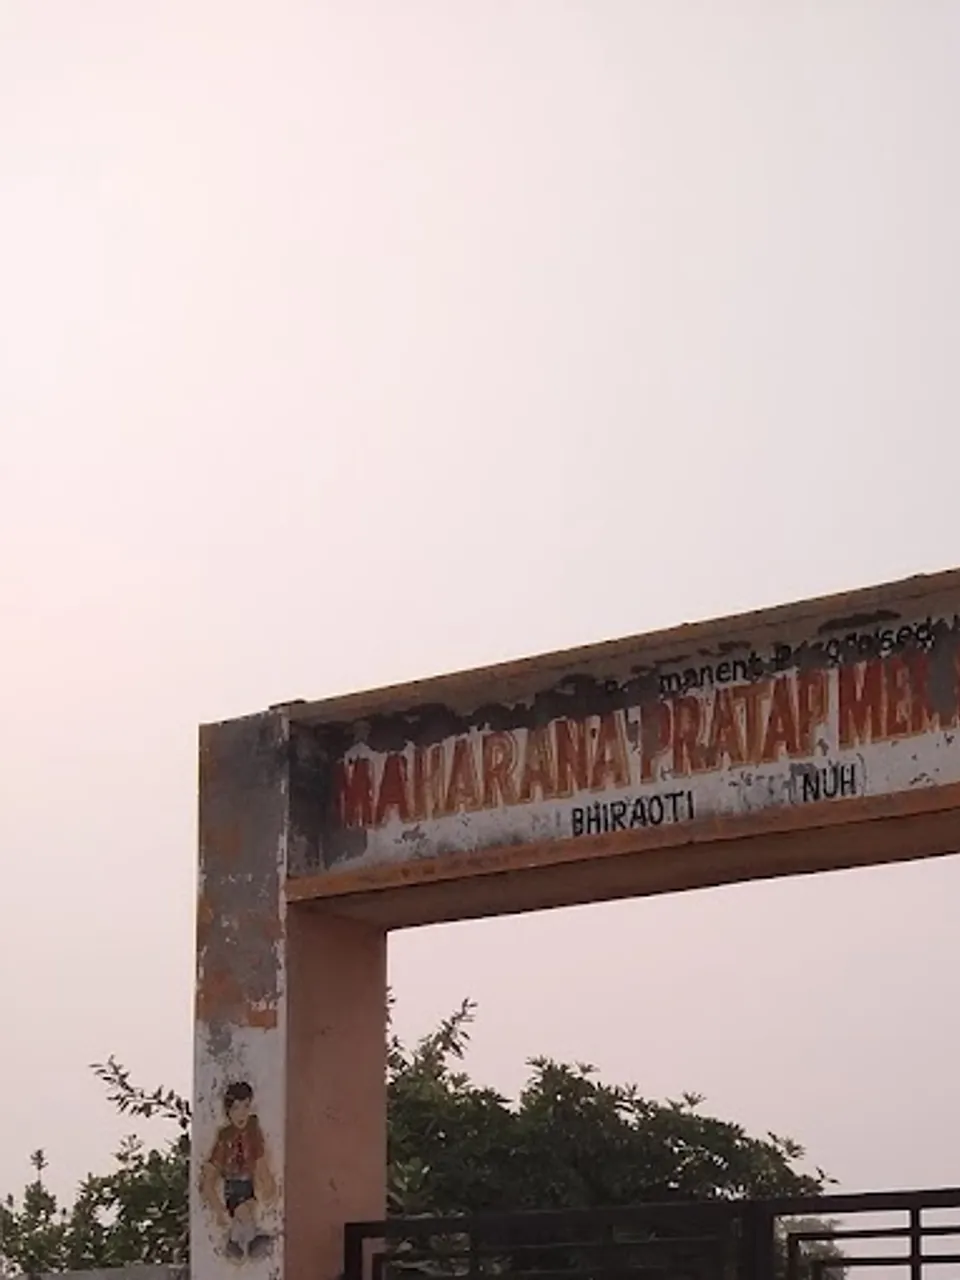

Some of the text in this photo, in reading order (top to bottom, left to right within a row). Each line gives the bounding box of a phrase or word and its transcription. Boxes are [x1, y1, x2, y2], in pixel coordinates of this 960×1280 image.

[338, 706, 631, 829] MAHARANA
[639, 664, 829, 784] PRATAP
[572, 790, 694, 836] BHIRAOTI
